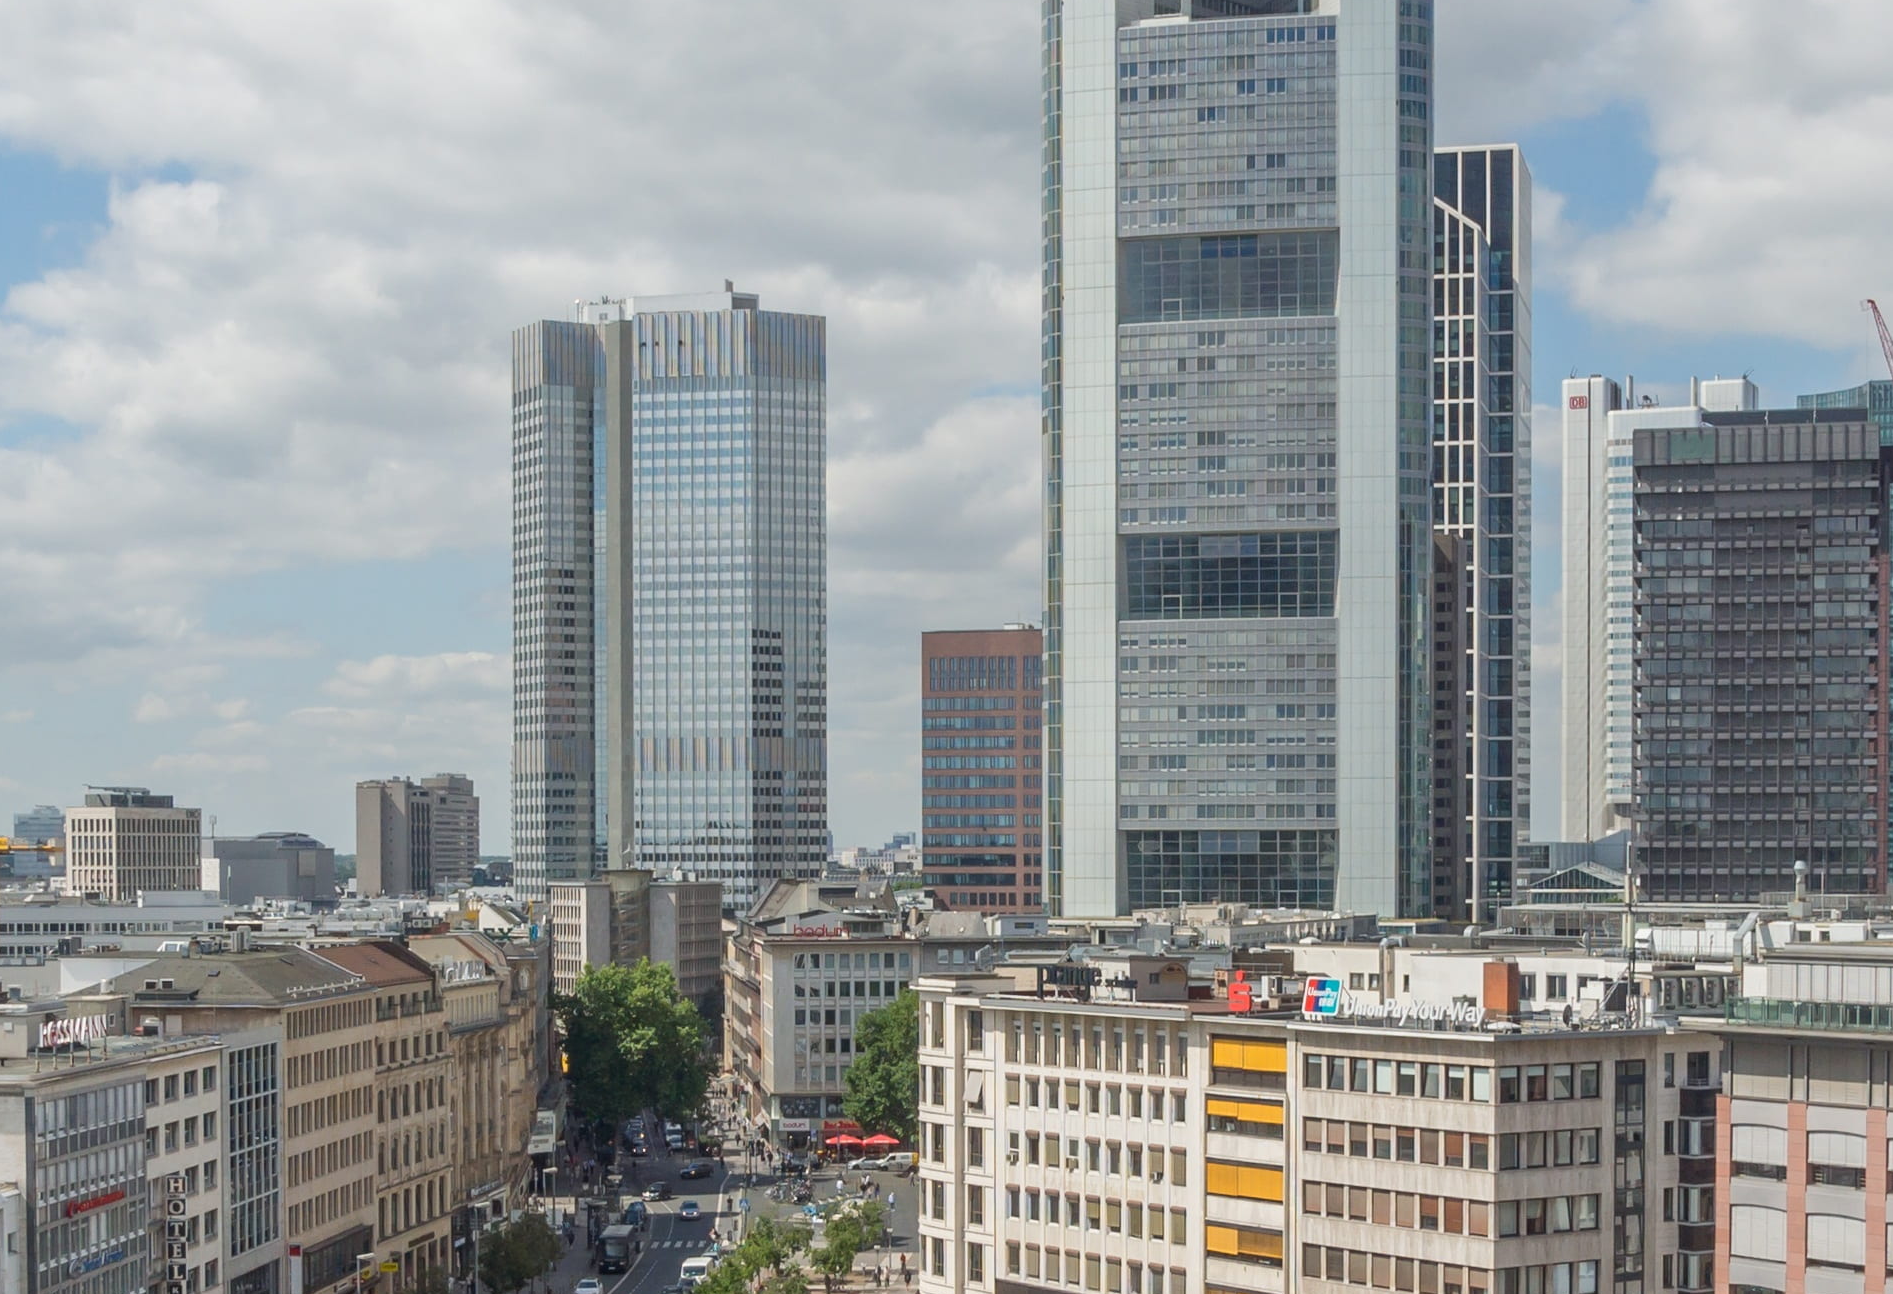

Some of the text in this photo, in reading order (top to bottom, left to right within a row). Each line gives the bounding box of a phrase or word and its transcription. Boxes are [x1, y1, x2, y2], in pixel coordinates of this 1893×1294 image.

[793, 923, 850, 939] bodum
[1036, 964, 1102, 1002] prange
[1343, 996, 1486, 1028] UnionPay Your Way
[168, 1177, 187, 1280] HOTEL
